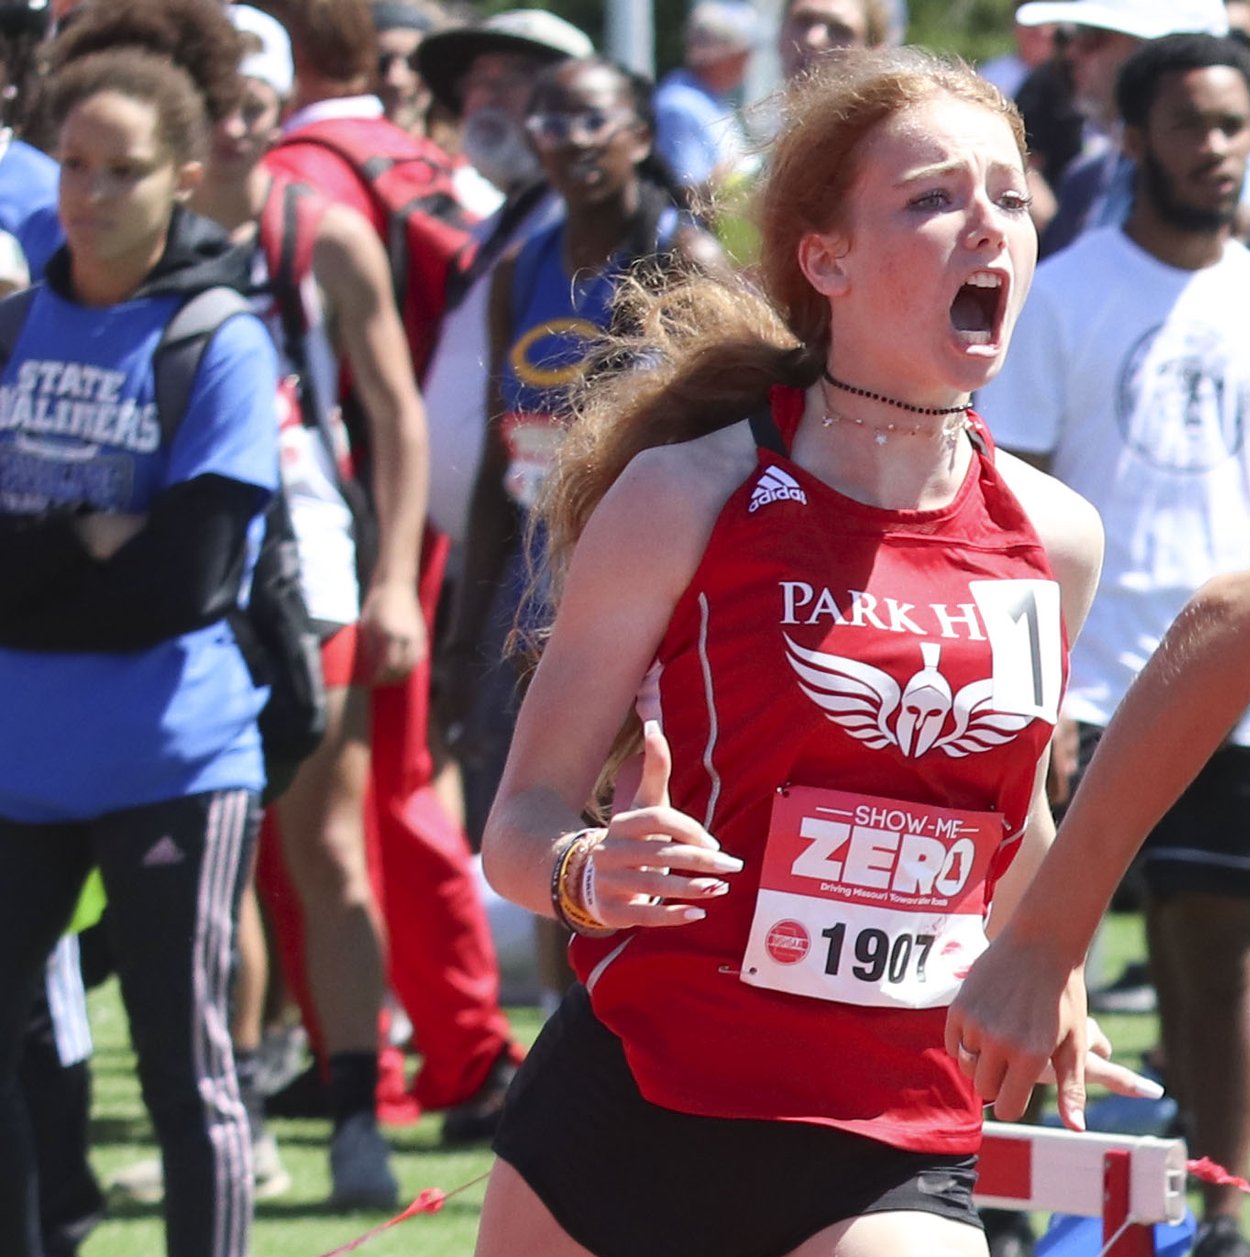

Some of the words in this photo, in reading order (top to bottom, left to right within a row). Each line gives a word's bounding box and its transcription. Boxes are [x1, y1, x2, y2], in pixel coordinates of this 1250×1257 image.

[19, 359, 126, 403] STATE
[749, 486, 807, 513] adidas
[778, 581, 927, 635] PARK
[929, 603, 987, 641] H
[1008, 589, 1043, 707] 1
[855, 805, 963, 838] SHOW-ME
[791, 816, 975, 897] ZERO
[820, 882, 852, 897] Driving
[852, 887, 889, 901] Missouri
[822, 922, 935, 983] 1907
